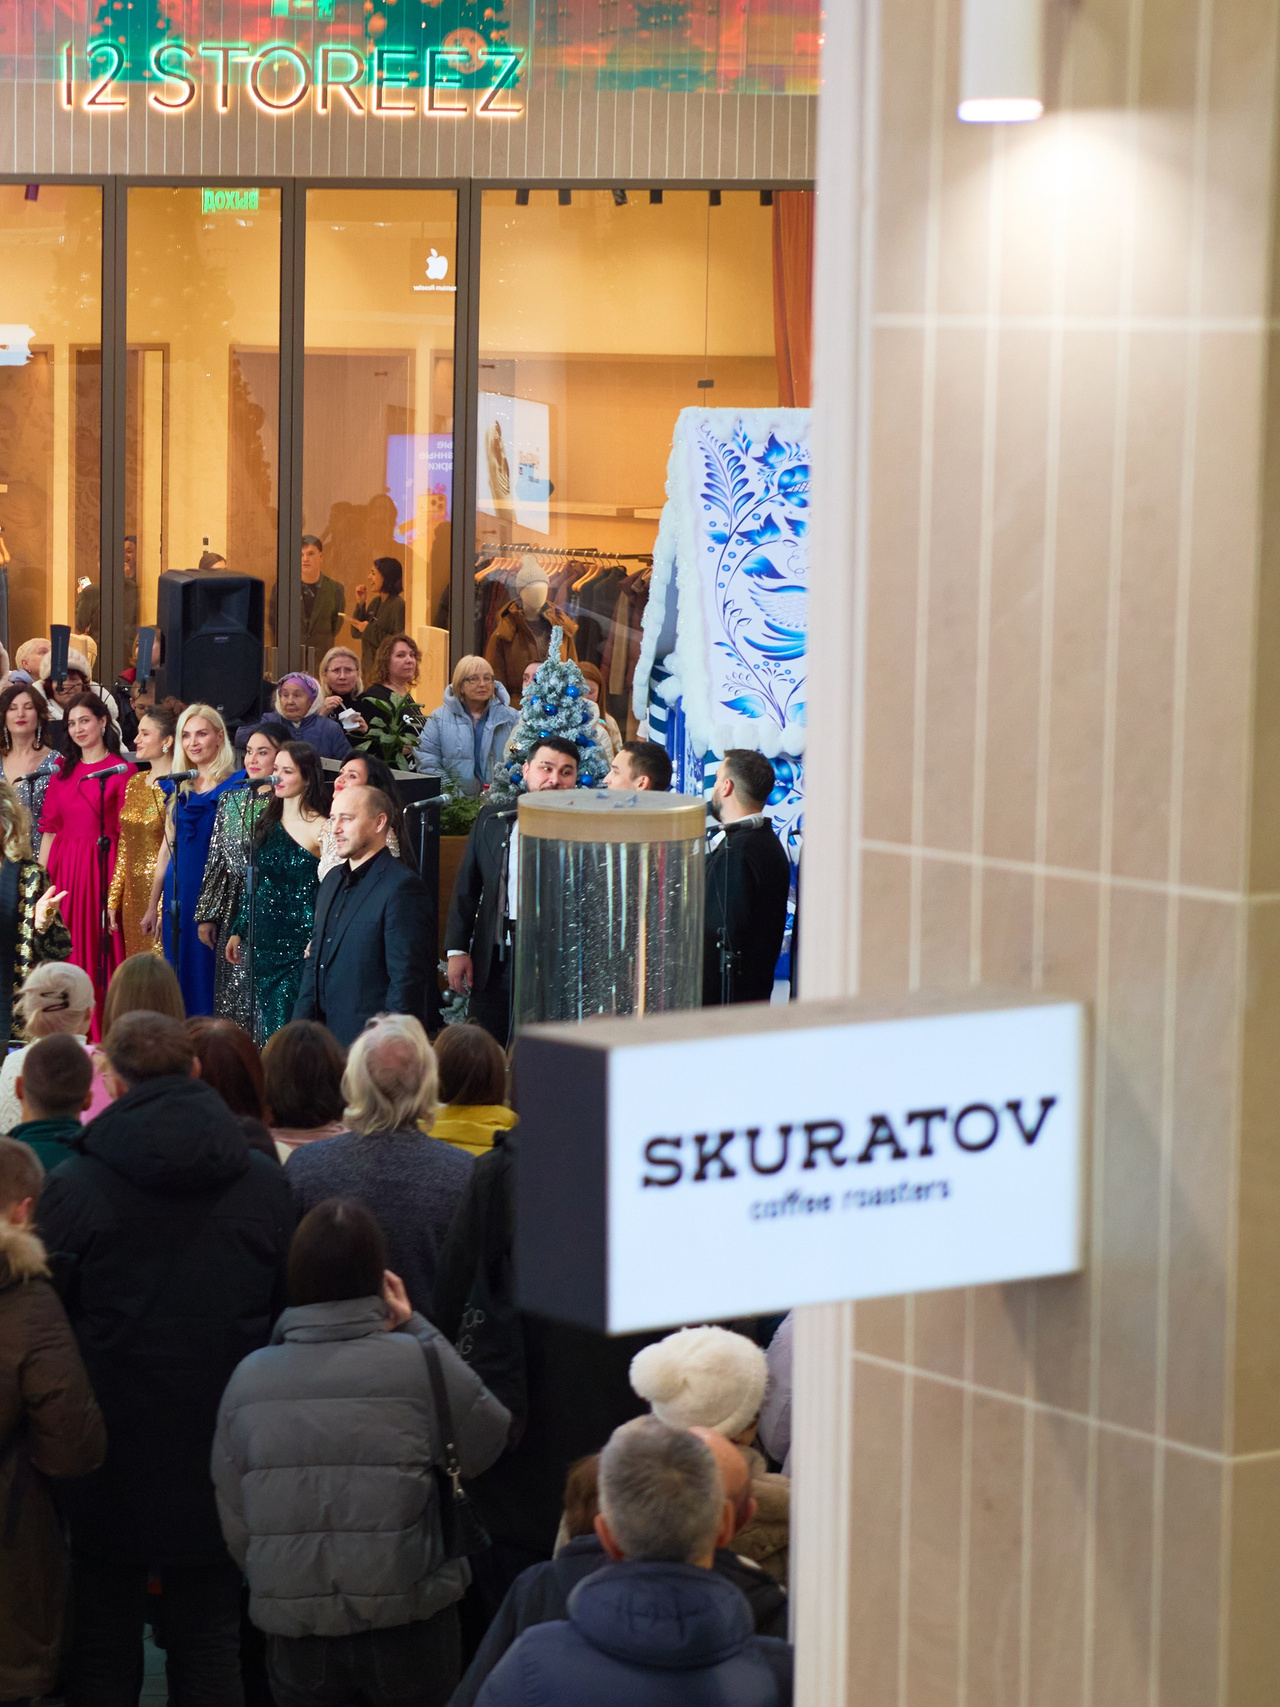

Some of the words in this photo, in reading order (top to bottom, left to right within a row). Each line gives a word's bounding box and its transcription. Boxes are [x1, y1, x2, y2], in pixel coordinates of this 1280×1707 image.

[61, 42, 128, 111] 12
[149, 42, 525, 117] STOREEZ
[642, 1096, 1058, 1188] SKURATOV
[749, 1188, 832, 1221] coffee
[843, 1178, 951, 1212] roasters
